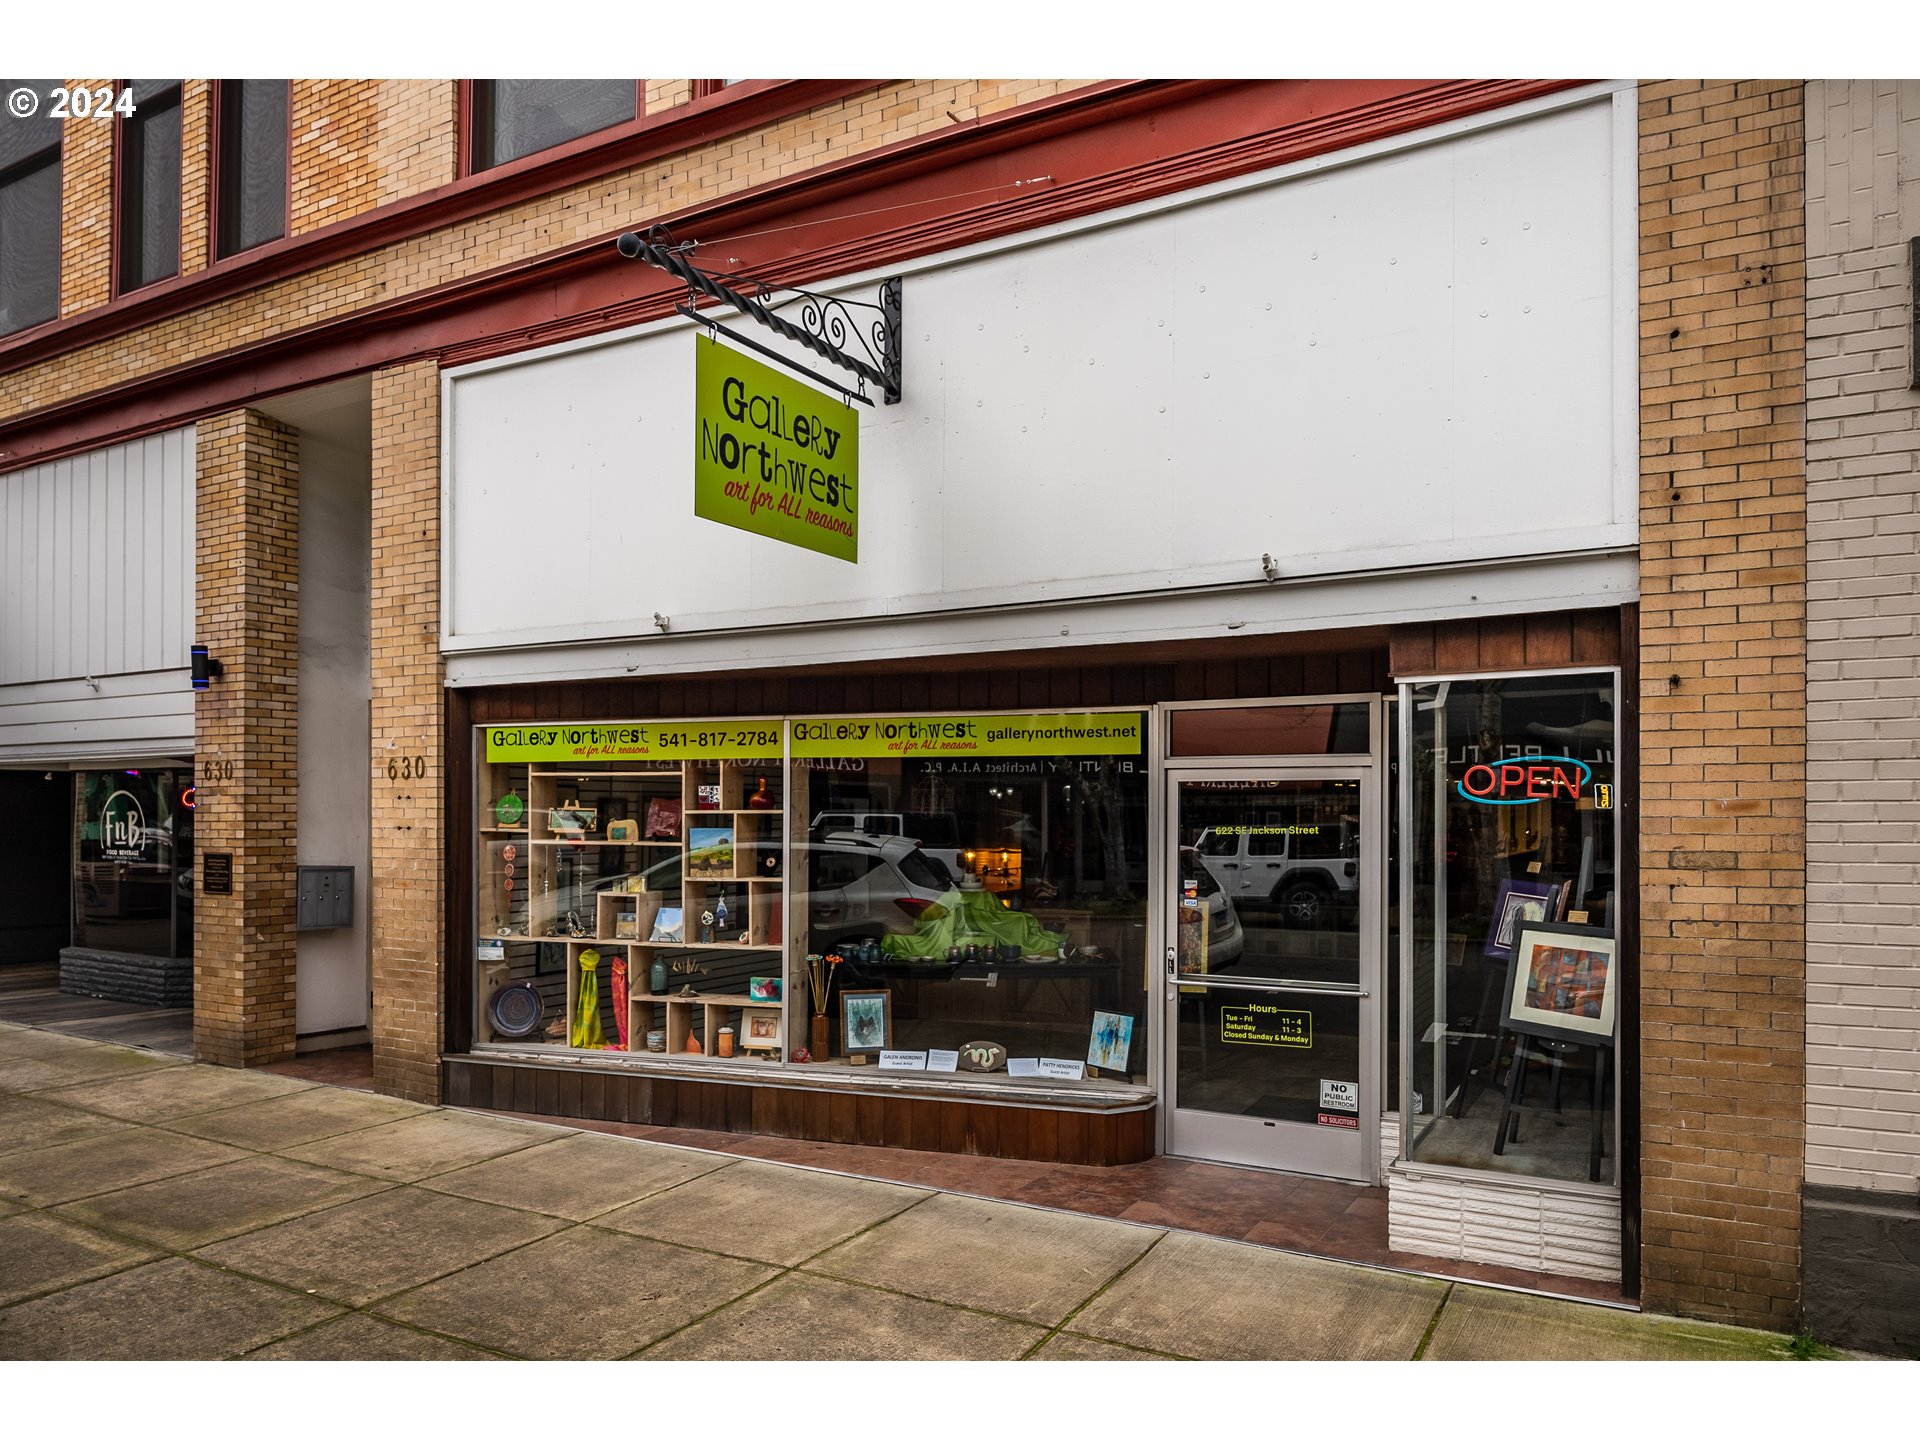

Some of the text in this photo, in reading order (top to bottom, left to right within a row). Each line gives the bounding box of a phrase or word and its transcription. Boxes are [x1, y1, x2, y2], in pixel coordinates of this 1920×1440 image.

[702, 417, 854, 514] Northwest
[724, 480, 854, 538] art for ALL reasons
[562, 726, 649, 744] Northwest
[658, 731, 779, 748] 541-817-2784
[875, 719, 978, 739] Northwest
[986, 725, 1136, 743] gallerynorthwest.net
[573, 744, 650, 758] art for ALL reasons
[887, 738, 978, 755] art for ALL reasons
[203, 759, 234, 782] 630
[387, 755, 426, 781] 630
[1463, 764, 1582, 799] OPEN
[105, 810, 140, 849] FnB
[1215, 825, 1319, 835] 622 SE Jackson Street
[1248, 1003, 1278, 1014] Hours
[1225, 1022, 1256, 1032] Saturday
[1223, 1031, 1247, 1039] Closed
[1247, 1032, 1274, 1042] Sunday
[1280, 1035, 1309, 1044] Monday
[1330, 1083, 1347, 1093] NO
[1323, 1099, 1355, 1108] RESTROOM
[1324, 1092, 1353, 1102] PUBLIC
[1320, 1115, 1357, 1127] NO SOLICITORS
